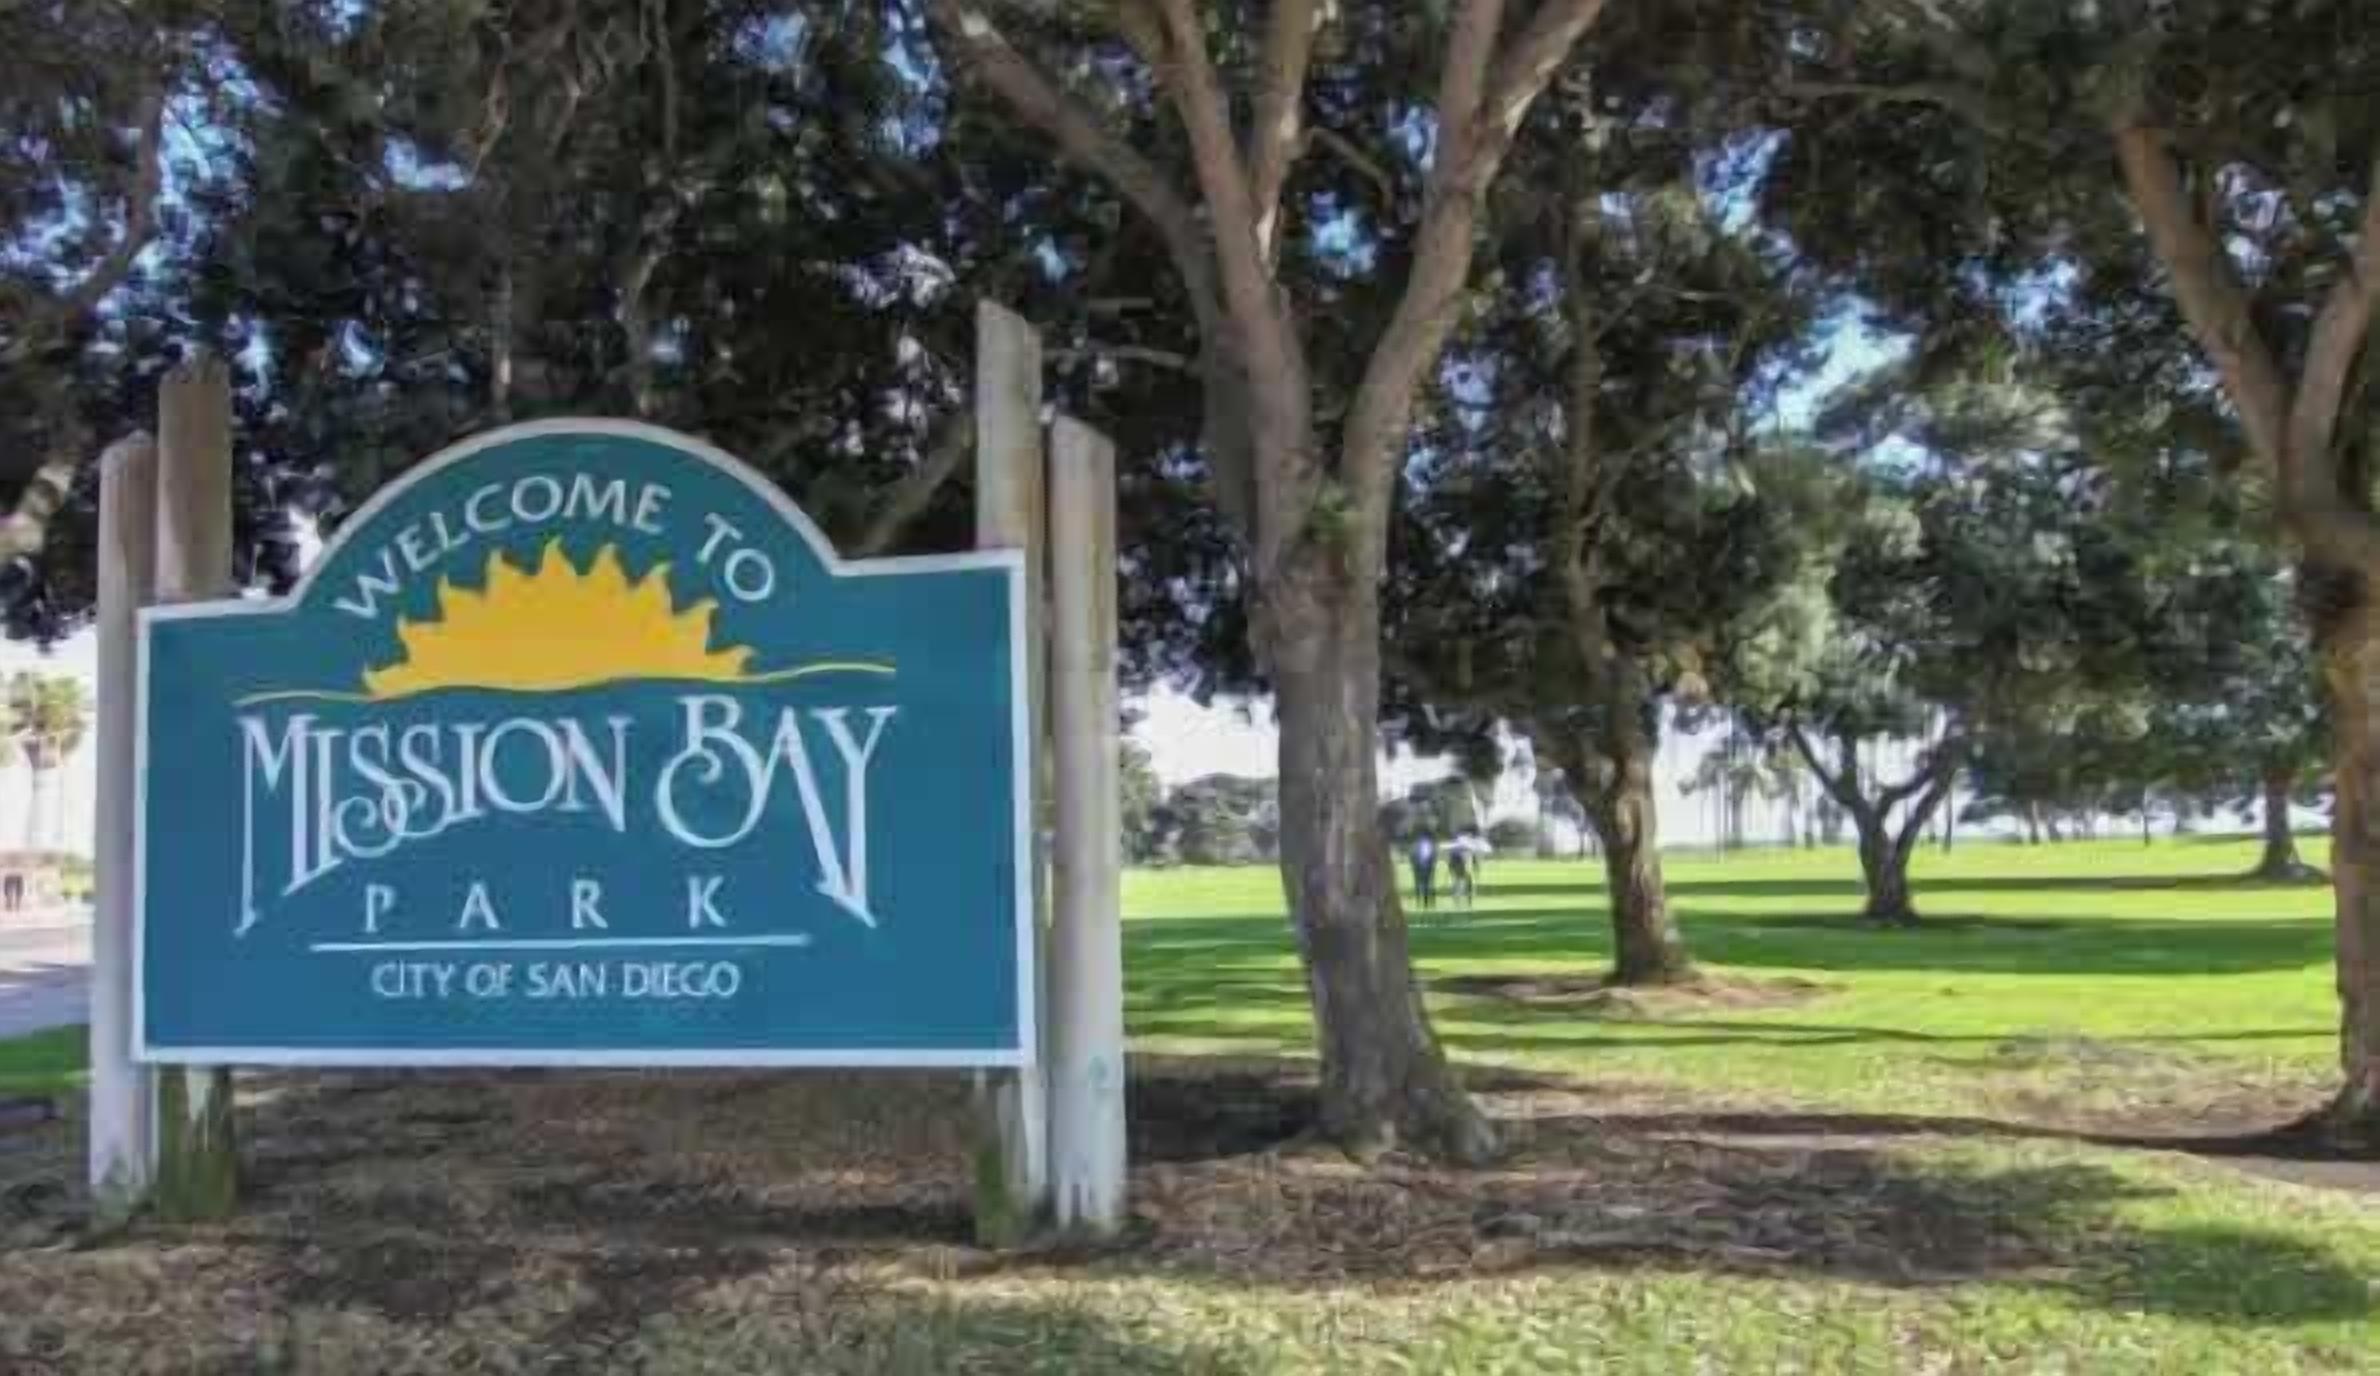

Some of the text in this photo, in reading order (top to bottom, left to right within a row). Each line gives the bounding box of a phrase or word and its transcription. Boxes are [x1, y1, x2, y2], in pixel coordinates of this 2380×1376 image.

[338, 475, 777, 618] WELCOME TO
[235, 693, 899, 937] MISSION BAY
[365, 875, 728, 934] PARK
[370, 960, 741, 1000] CITY OF SAN DIEGO
